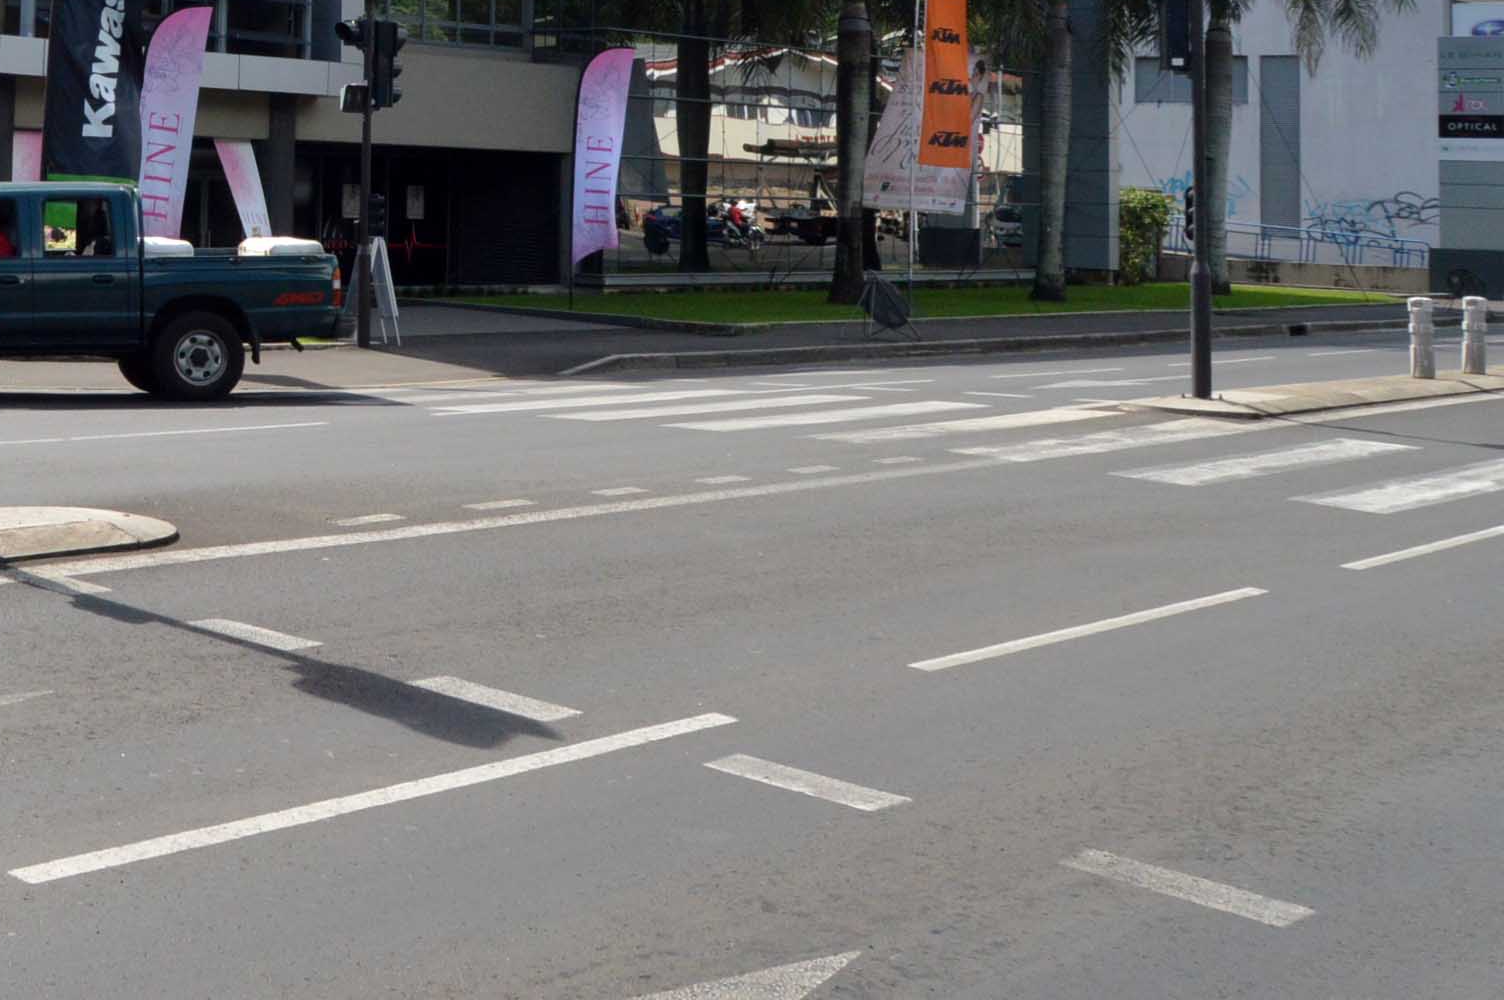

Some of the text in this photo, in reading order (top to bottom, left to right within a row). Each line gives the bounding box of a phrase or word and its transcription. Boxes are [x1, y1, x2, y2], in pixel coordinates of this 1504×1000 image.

[932, 27, 961, 44] KTM
[928, 78, 969, 96] KTM
[1447, 122, 1497, 131] OPTICAL
[928, 131, 968, 148] KTM
[143, 111, 182, 220] HINE
[584, 136, 614, 227] HINE
